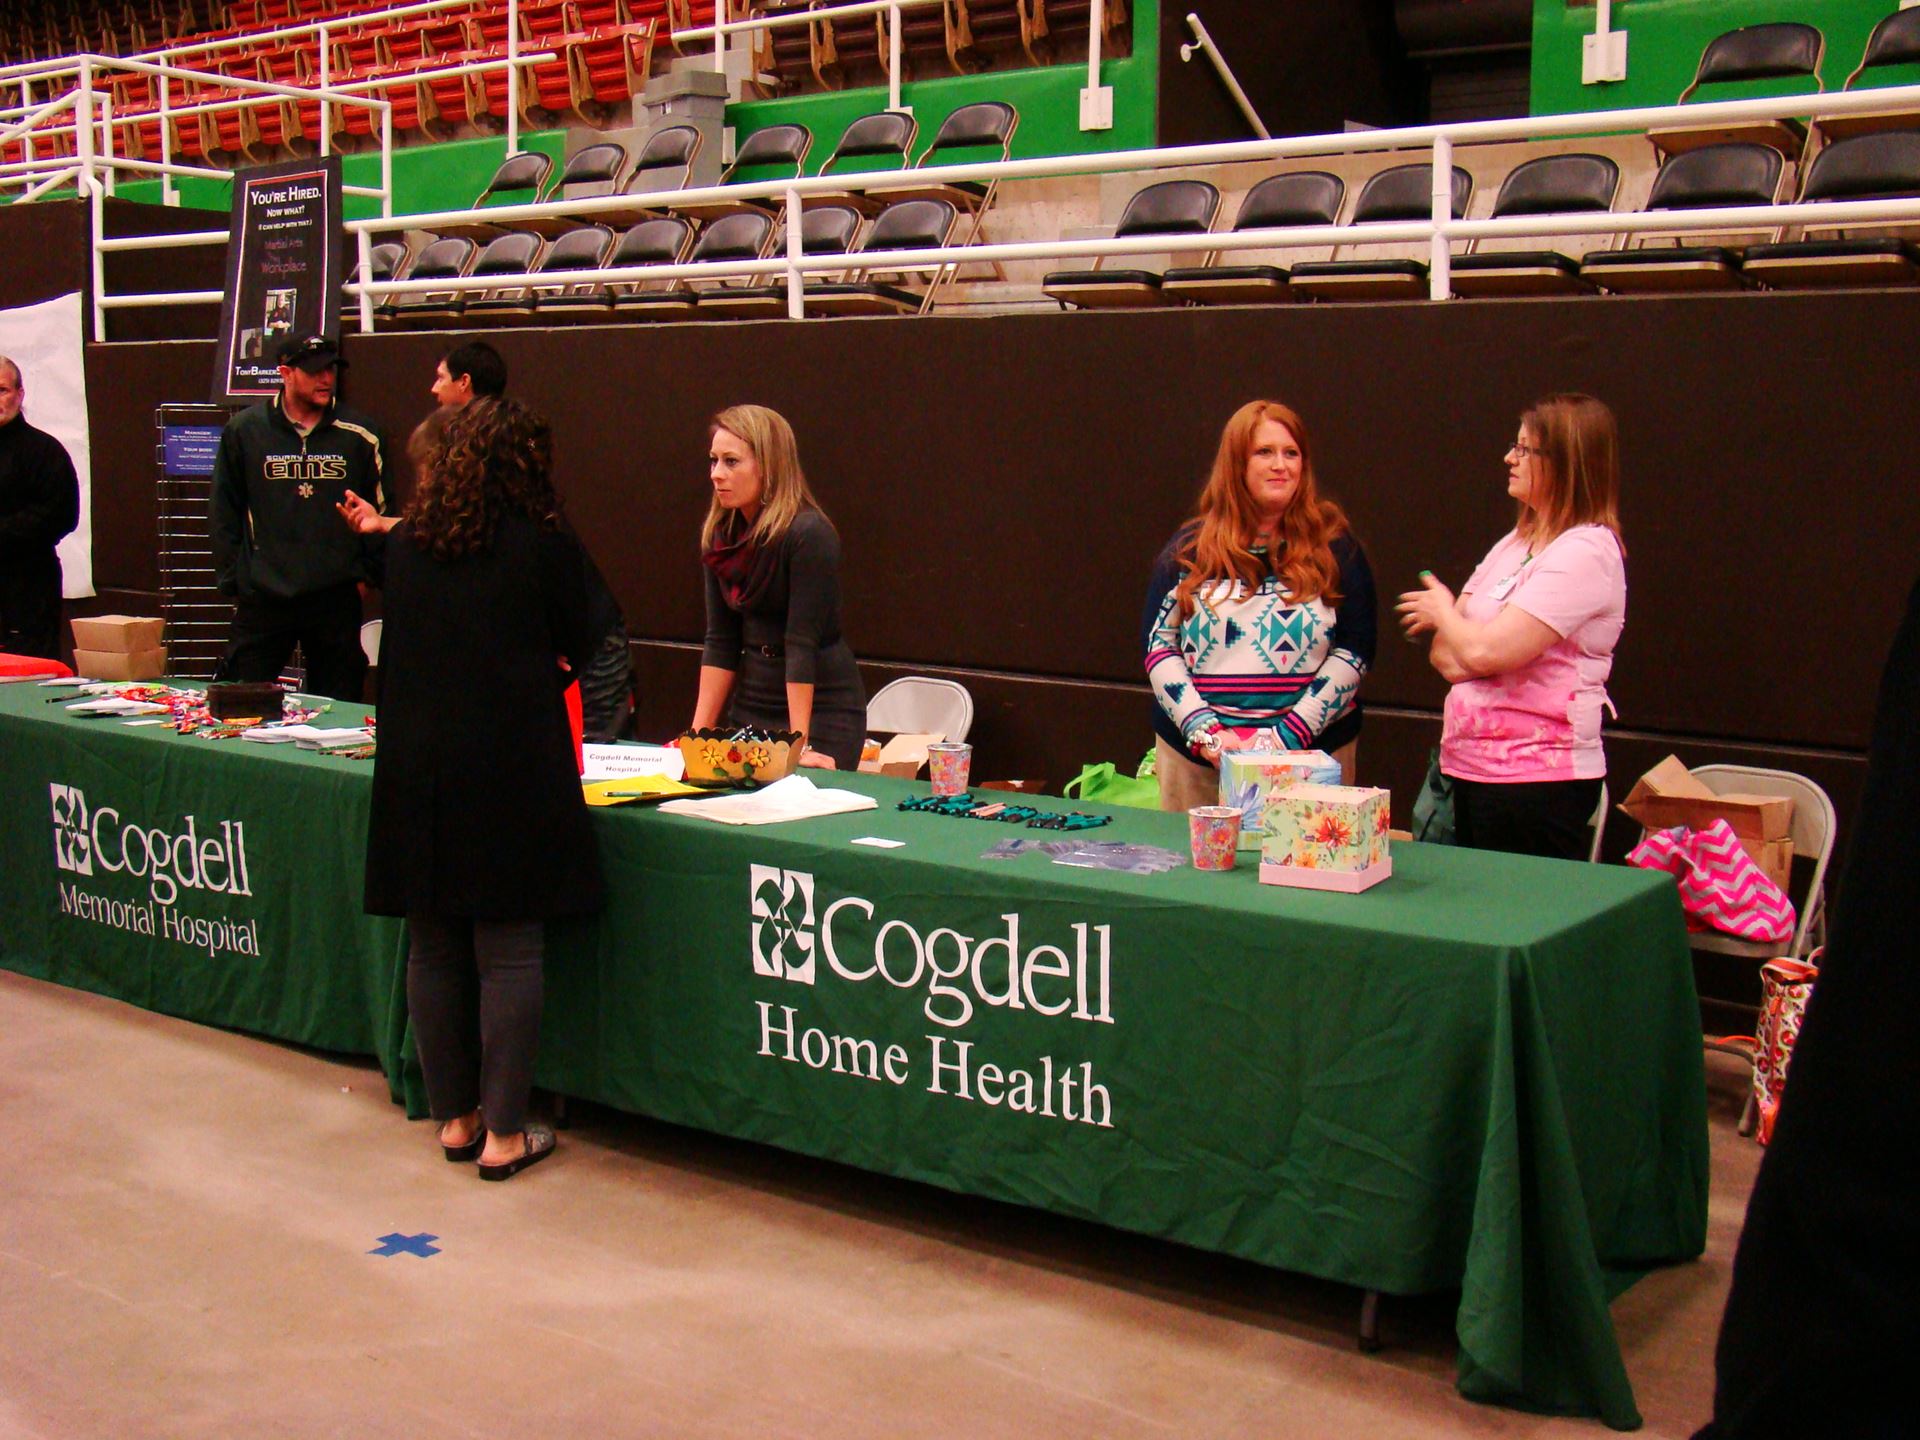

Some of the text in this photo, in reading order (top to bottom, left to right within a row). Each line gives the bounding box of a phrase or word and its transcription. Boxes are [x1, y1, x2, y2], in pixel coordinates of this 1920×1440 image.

[251, 186, 321, 205] YOU'RE HIRED.
[589, 753, 662, 763] Cogdell Memorial
[91, 806, 253, 905] Cogdell
[58, 882, 261, 957] Memorial Hospital
[822, 896, 1115, 1027] Cogdell
[755, 1001, 1115, 1128] Home Health
